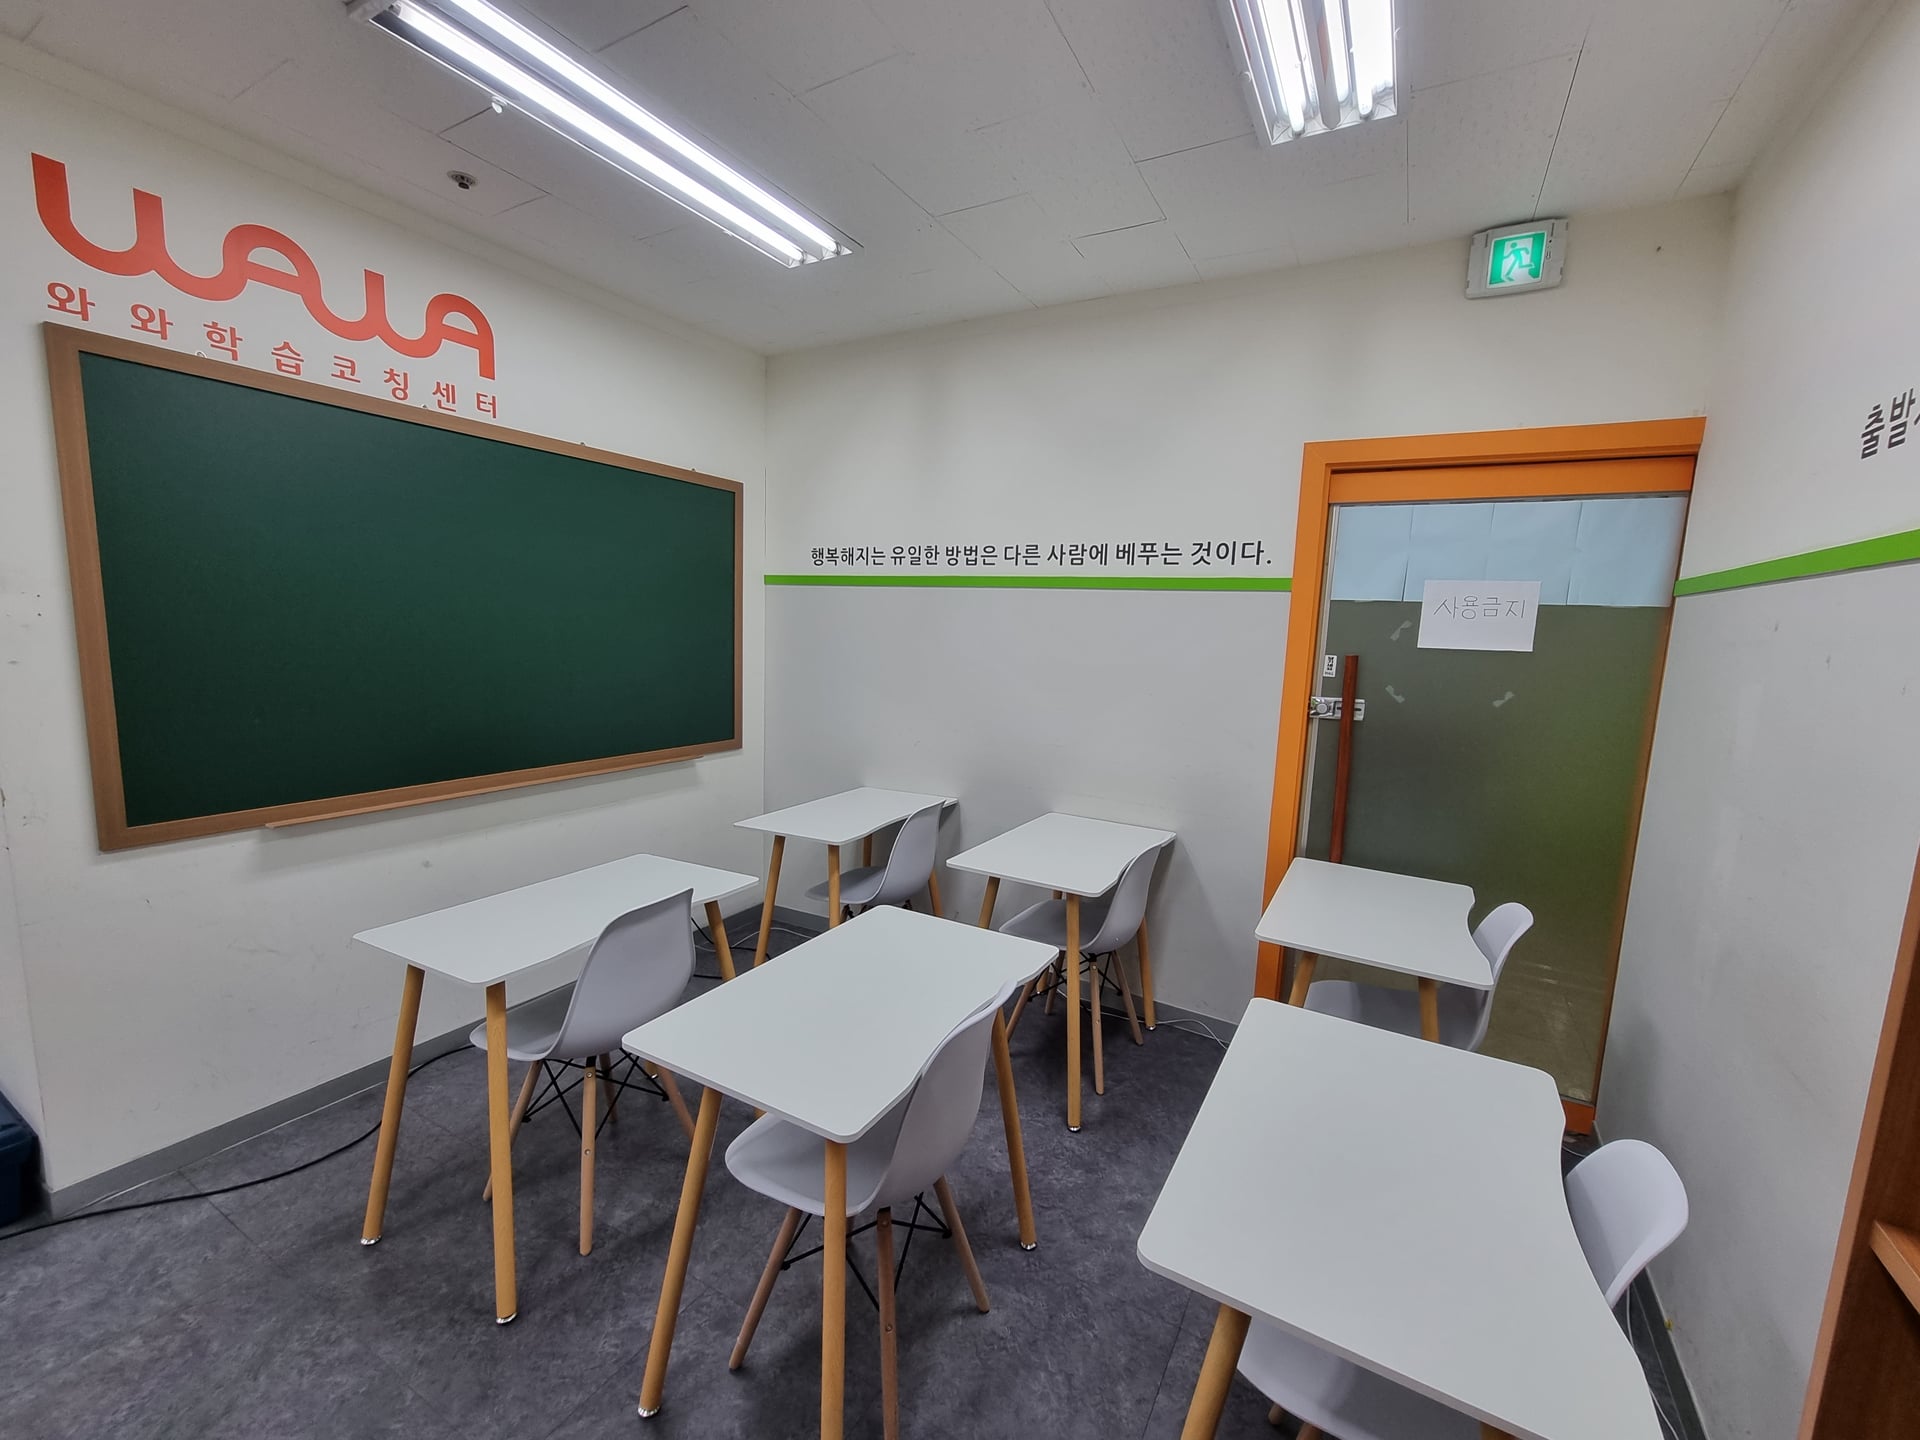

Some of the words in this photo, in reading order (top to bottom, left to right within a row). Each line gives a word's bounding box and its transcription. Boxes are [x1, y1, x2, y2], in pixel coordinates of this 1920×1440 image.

[1860, 388, 1920, 460] 출발
[811, 546, 886, 566] 행복해지는
[890, 545, 940, 566] 유일한
[945, 545, 998, 566] 방법은
[1004, 544, 1041, 566] 다른
[1047, 543, 1108, 566] 사람에
[1115, 542, 1183, 566] 베푸는
[1191, 540, 1272, 566] 것이다.
[1433, 595, 1525, 620] 사용금지
